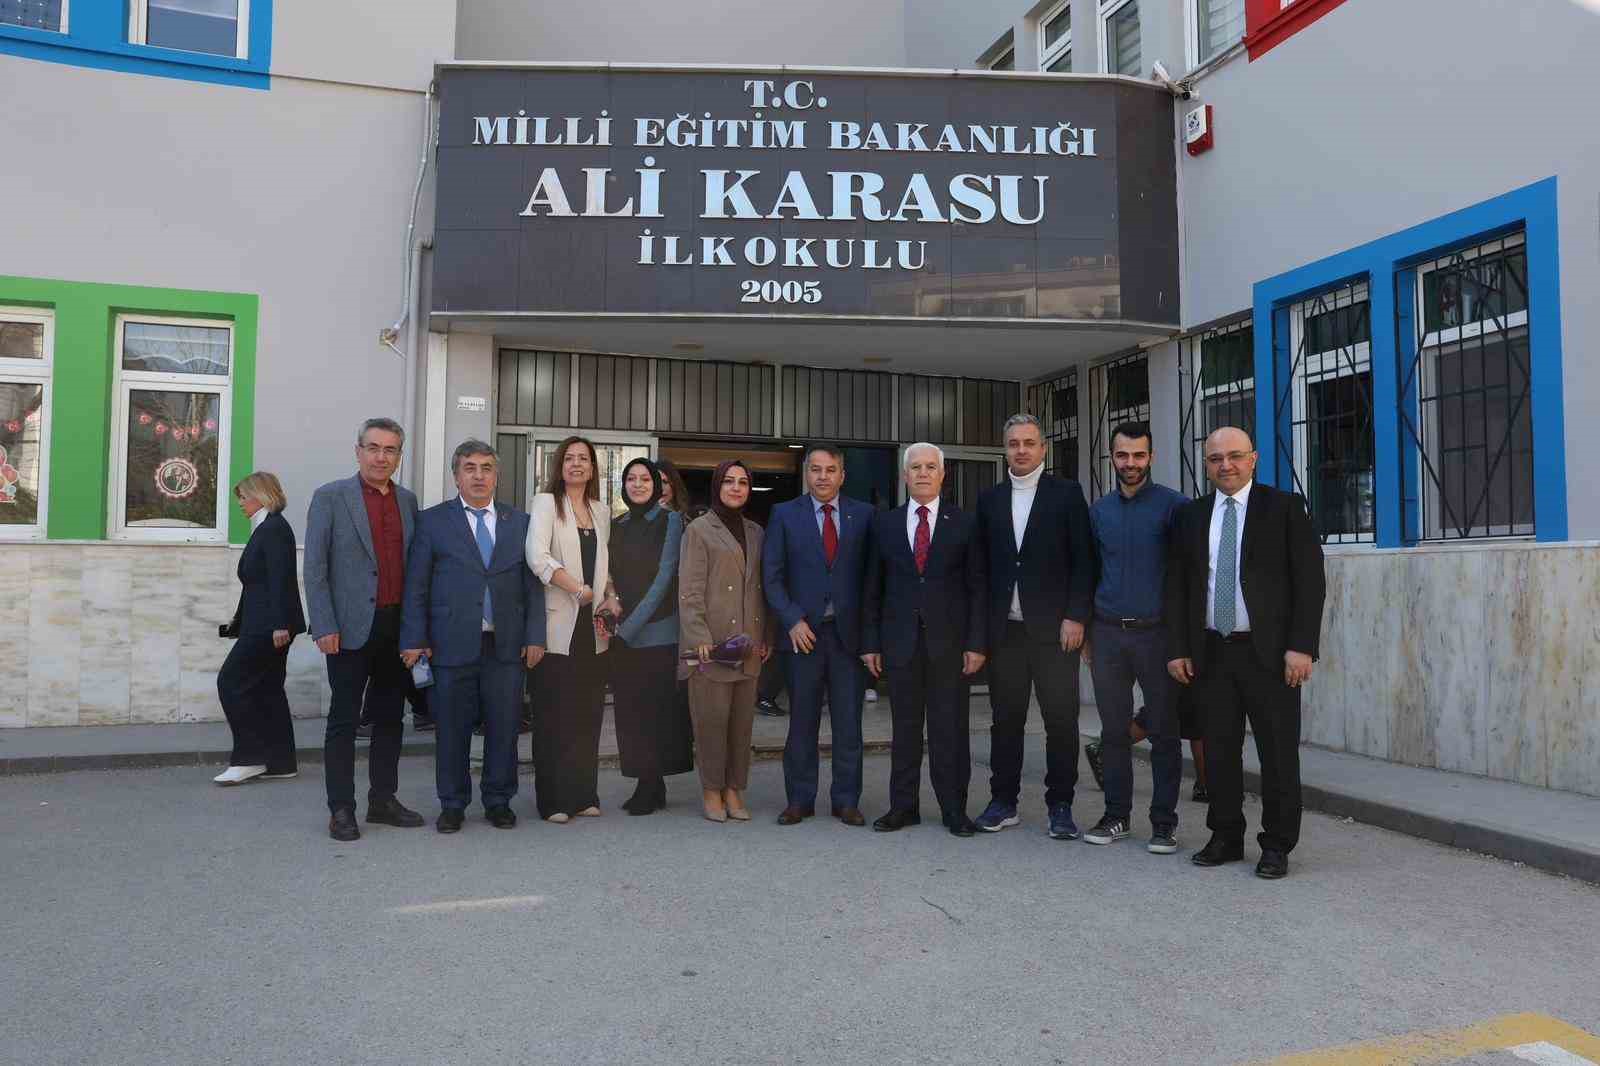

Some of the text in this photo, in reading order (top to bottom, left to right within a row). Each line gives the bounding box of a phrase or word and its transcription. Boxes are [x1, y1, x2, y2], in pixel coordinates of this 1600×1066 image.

[743, 79, 828, 110] T.C.
[472, 109, 1098, 157] MİLLİ EĞİTİM BAKANLIĞI
[519, 156, 1049, 226] ALİ KARASU
[637, 228, 928, 271] İLKOKULU
[740, 279, 823, 304] 2005
